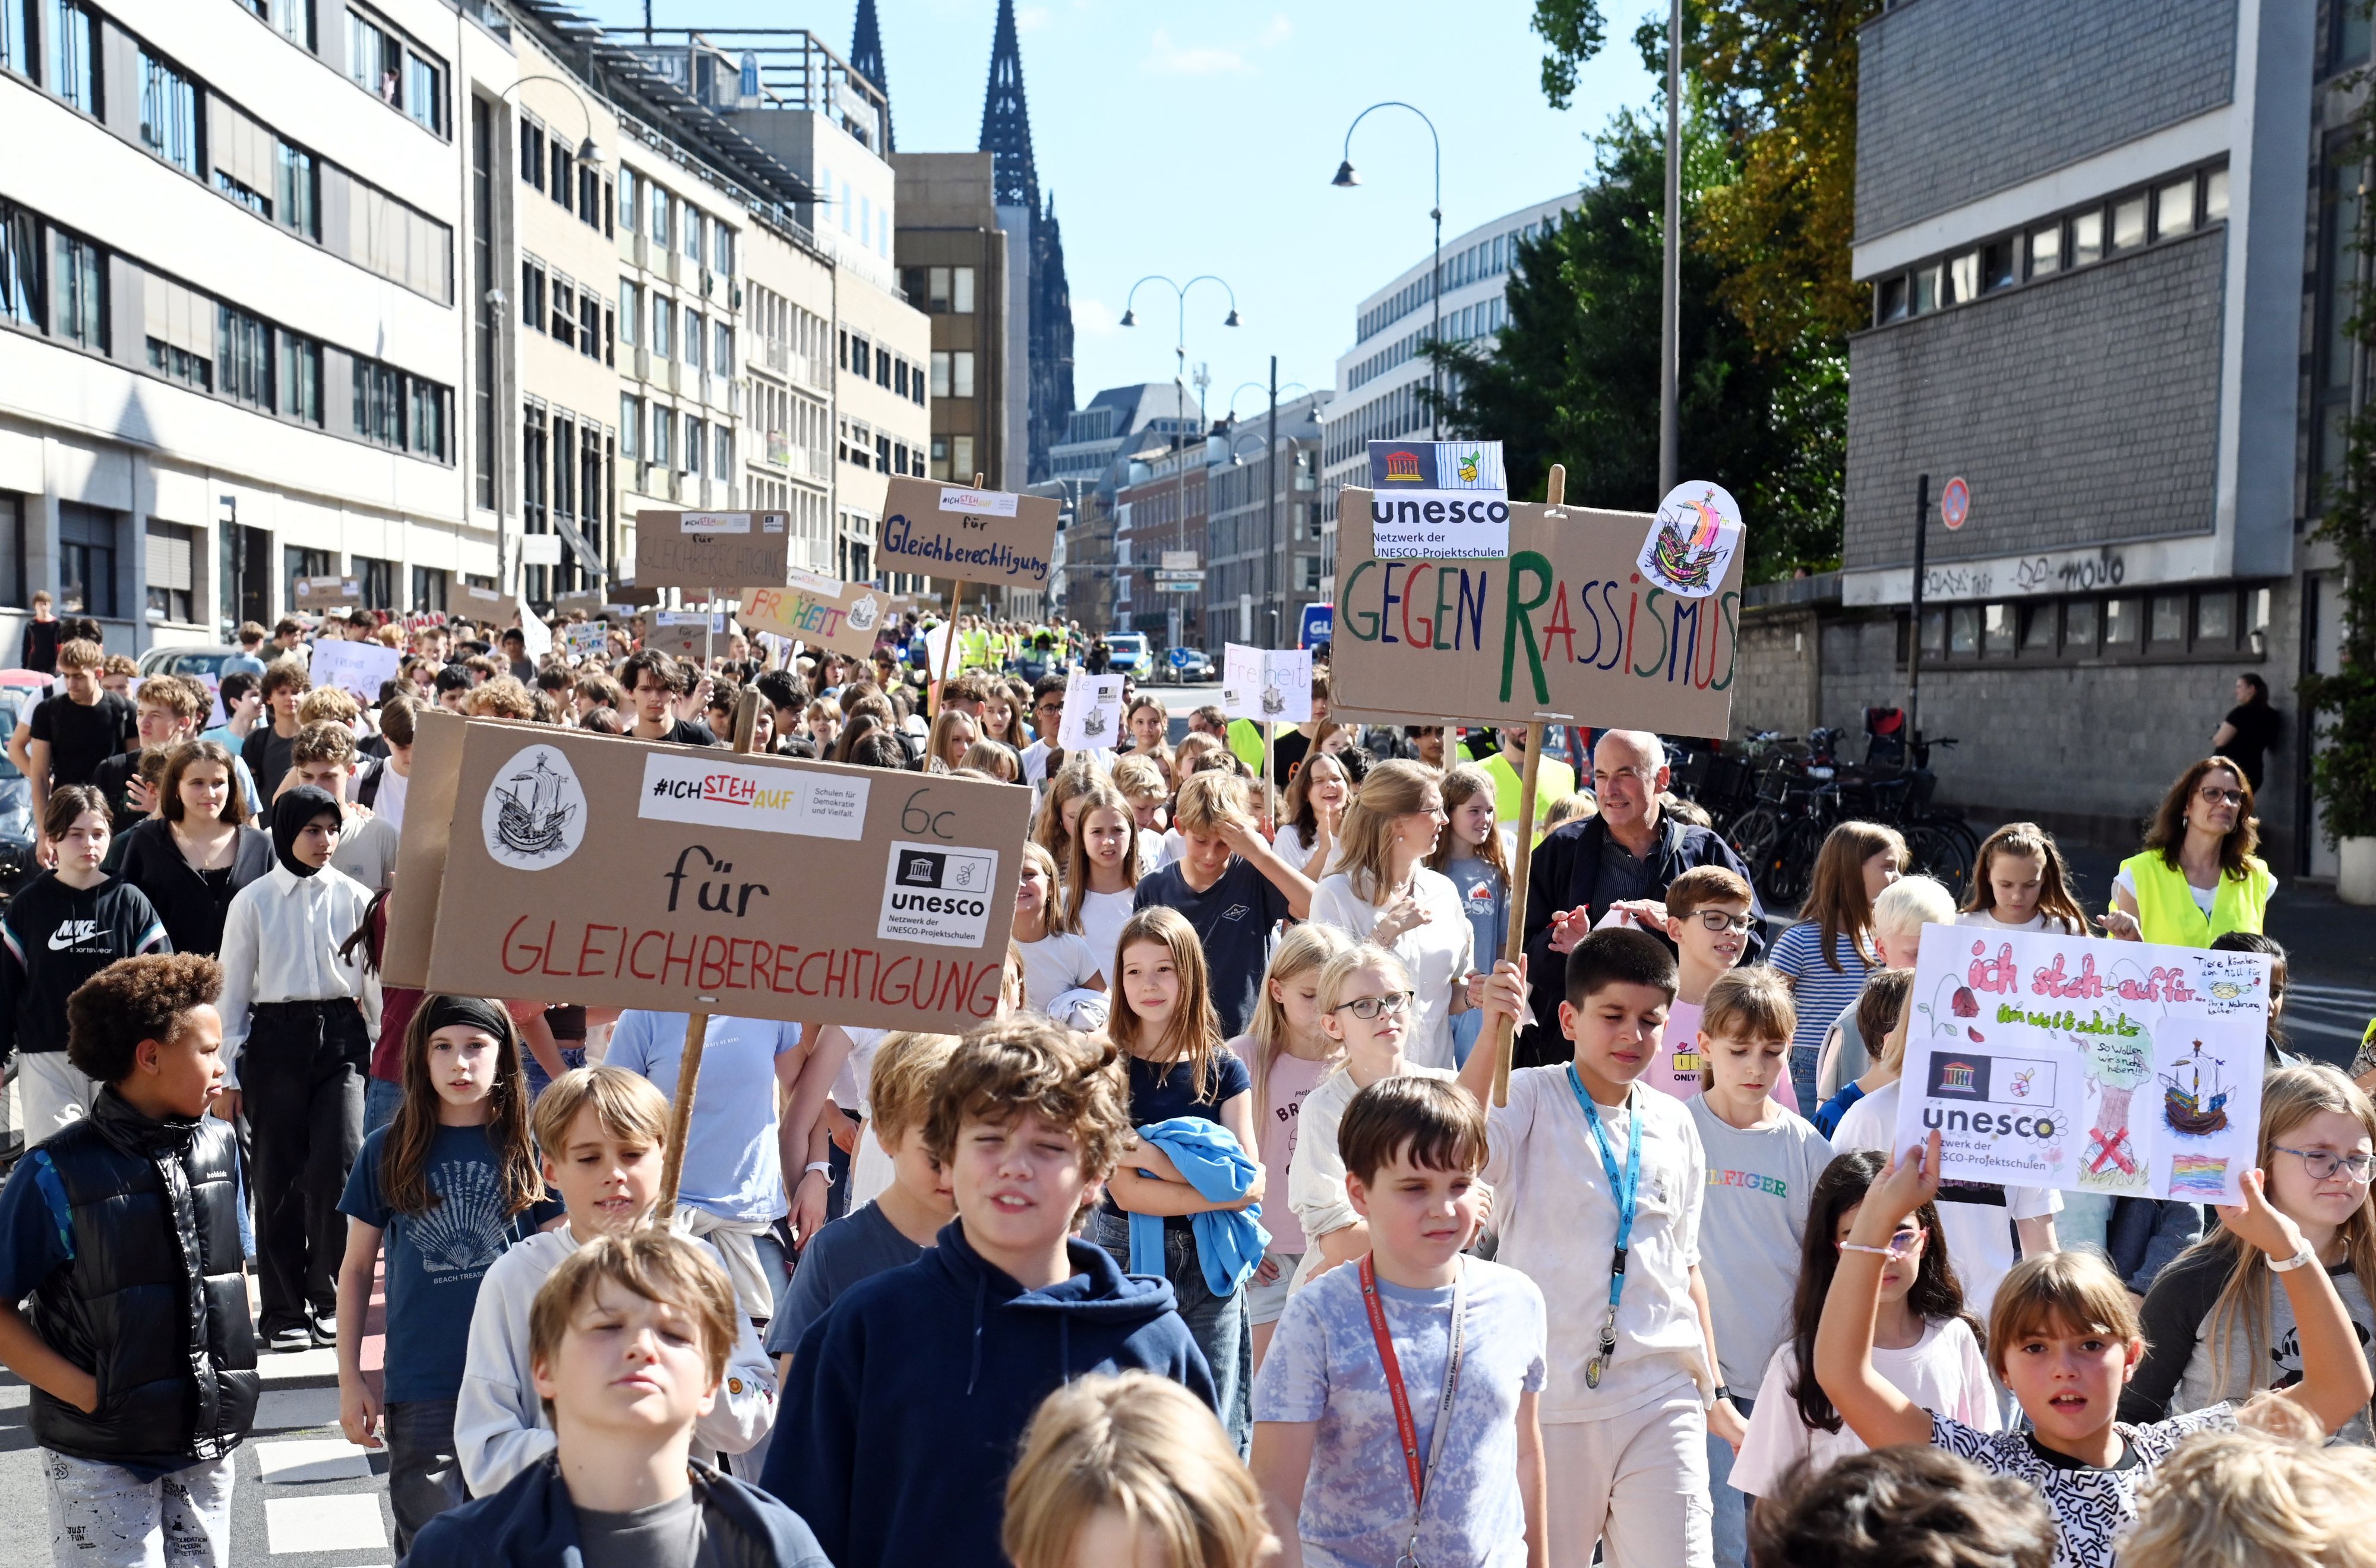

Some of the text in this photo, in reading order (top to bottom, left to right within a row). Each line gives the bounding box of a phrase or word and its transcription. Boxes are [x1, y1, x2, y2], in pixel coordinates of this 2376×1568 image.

[1372, 501, 1509, 523] unesco
[962, 516, 988, 531] für
[693, 533, 714, 543] für
[1373, 533, 1445, 542] Netzwerk der
[884, 514, 1047, 580] Gleichberechtigung
[1373, 548, 1503, 559] UNESCO-Projektschulen
[638, 536, 787, 580] GLEICHBERECHTIGUNG
[1341, 561, 1486, 650] GEGEN
[815, 788, 843, 798] Schulen
[813, 797, 855, 808] Demokratie
[664, 845, 770, 917] für
[892, 893, 984, 916] unesco
[58, 920, 96, 937] NIKE
[889, 915, 939, 926] Netzwerk der
[887, 925, 975, 940] UNESCO-Projektschulen
[502, 914, 1000, 1018] GLEICHBERECHTIGUNG
[1968, 940, 2017, 994] ich
[1923, 1108, 2055, 1139] unesco
[1920, 1136, 1992, 1150] Nzwerk der
[1921, 1151, 2046, 1170] ESCO-Projektschulen
[434, 1275, 458, 1284] BEACH
[1443, 1374, 1455, 1411] FLYERALARM
